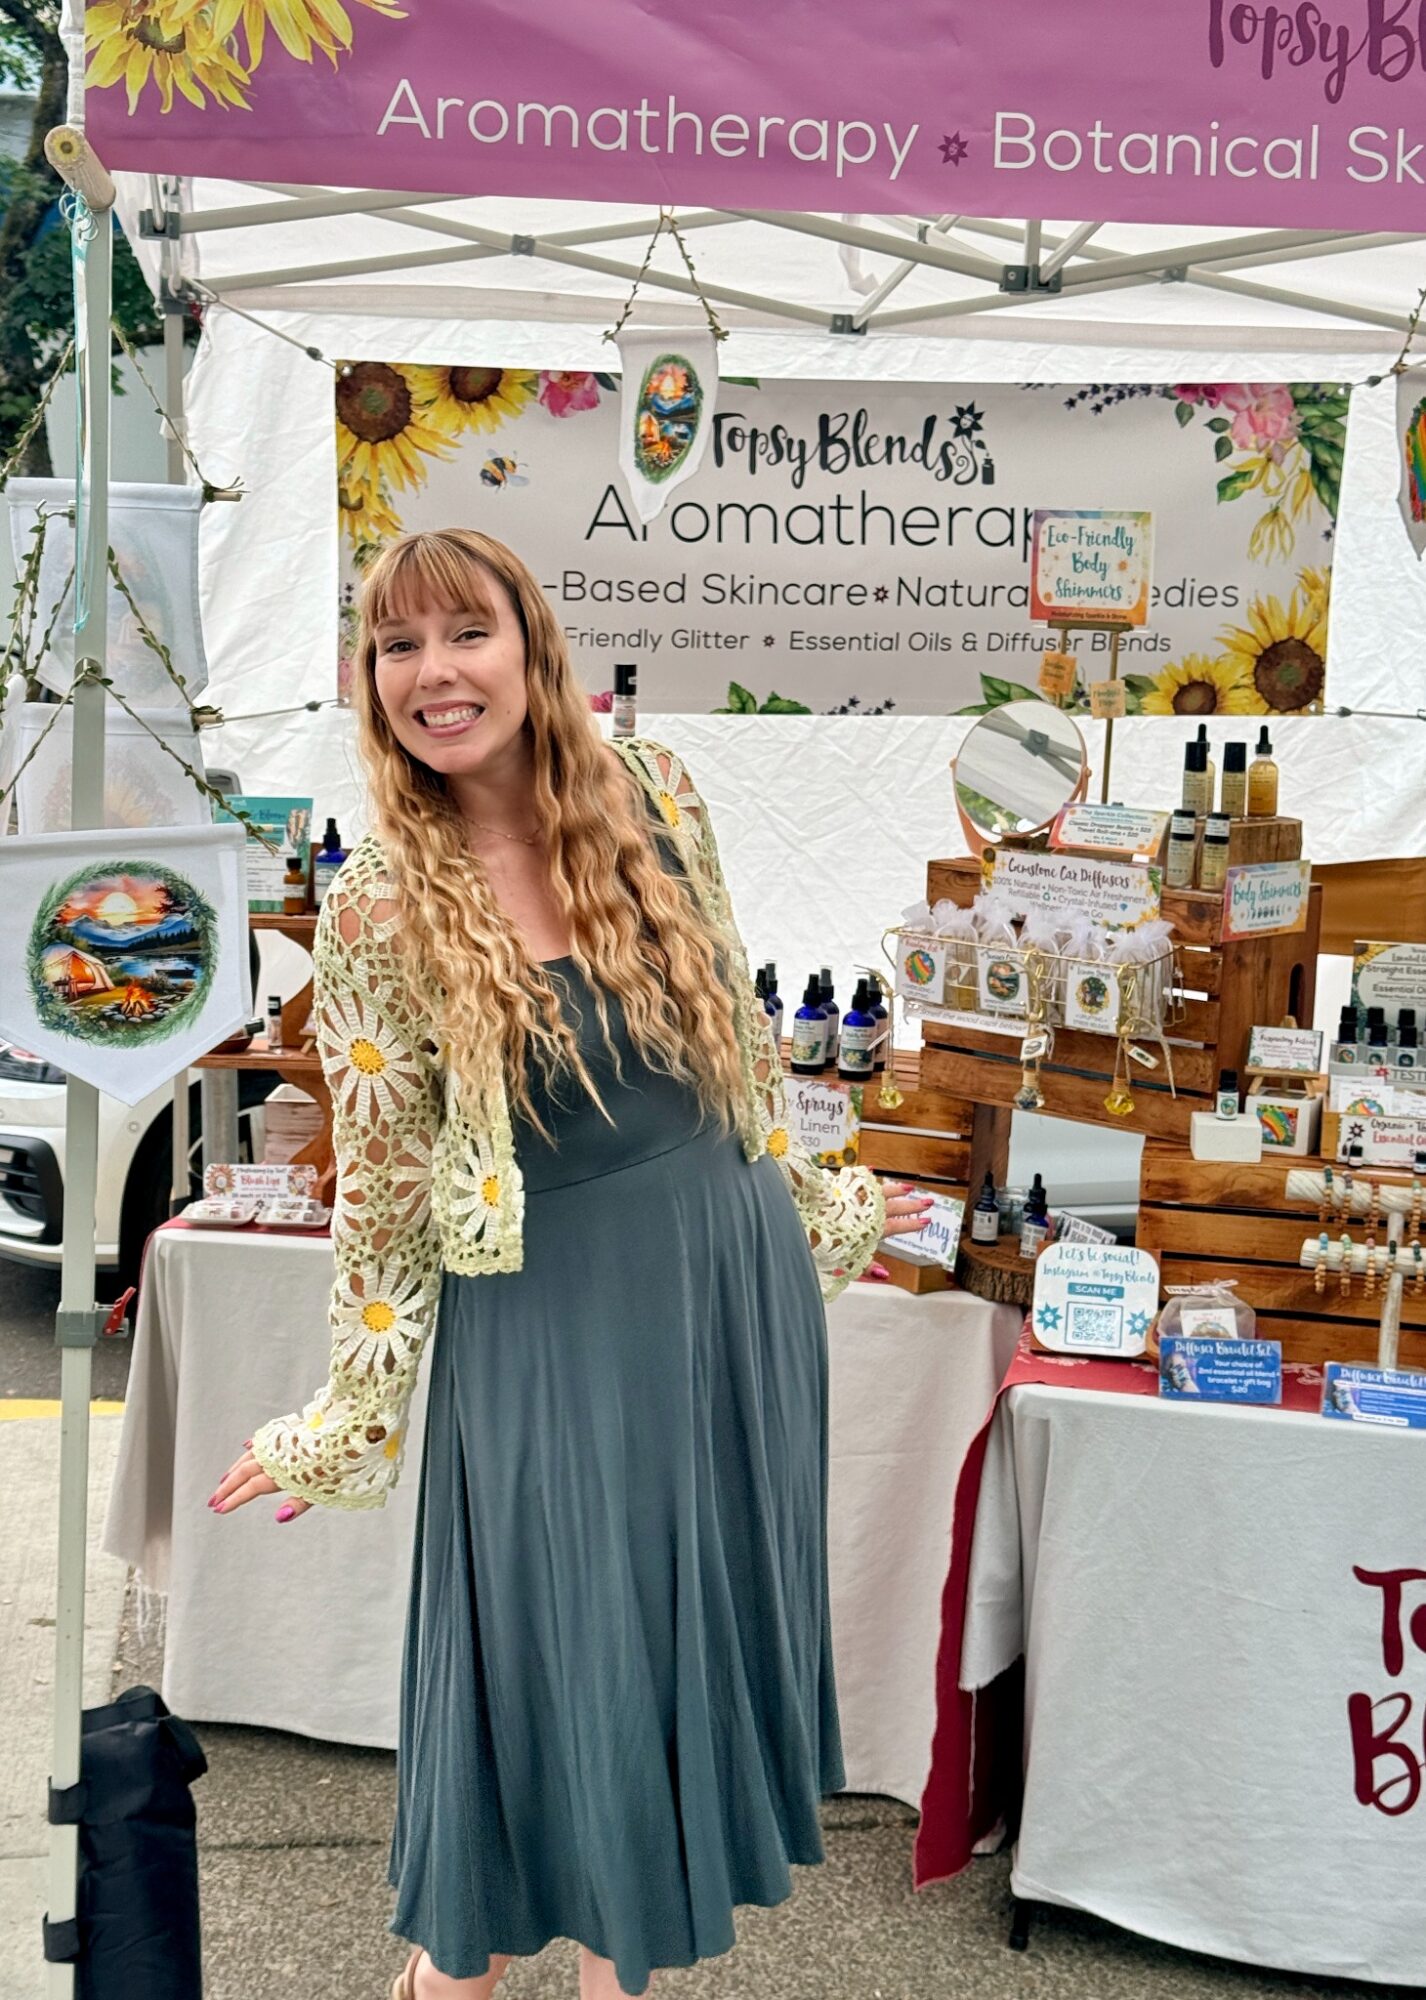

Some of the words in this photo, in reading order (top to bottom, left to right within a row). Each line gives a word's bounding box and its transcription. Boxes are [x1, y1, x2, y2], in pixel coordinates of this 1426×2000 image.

[376, 78, 920, 180] Aromatherapy
[993, 111, 1319, 180] Botanical
[1346, 126, 1426, 184] Sk
[1047, 524, 1135, 557] Eco-Friendly
[1071, 552, 1109, 582] Body
[702, 573, 868, 606] Skincare
[896, 576, 1029, 608] Natura
[1055, 577, 1123, 601] Shimmers
[671, 628, 750, 650] Glitter
[788, 630, 899, 652] Essential
[908, 631, 952, 652] Oils
[961, 631, 978, 652] &
[986, 631, 1084, 652] Diffuser
[1008, 857, 1057, 879] Gemstone
[1059, 865, 1078, 882] Car
[1080, 867, 1130, 890] Diffusers
[993, 875, 1013, 887] 100%
[1013, 878, 1041, 891] Natural
[1048, 883, 1089, 897] Non-Toxic
[1089, 889, 1101, 898] Air
[1103, 890, 1147, 905] Fresheners
[1008, 888, 1041, 900] Refillable
[1057, 894, 1118, 912] Crystal-Infused
[1090, 908, 1104, 919] Go
[1366, 963, 1405, 976] Straight
[1372, 983, 1415, 994] Essential
[1390, 1068, 1426, 1081] TEST
[796, 1090, 843, 1121] Sprays
[800, 1117, 840, 1135] Linen
[1370, 1119, 1406, 1131] Organic
[1058, 1245, 1084, 1262] Let's
[1087, 1247, 1098, 1262] be
[1101, 1249, 1141, 1267] social!
[1043, 1263, 1089, 1279] Instagram
[1074, 1285, 1101, 1295] SCAN
[1102, 1287, 1118, 1296] ME
[1174, 1340, 1214, 1357] Diffuser
[1215, 1341, 1255, 1357] Bracelet
[1255, 1343, 1272, 1358] Set
[1213, 1368, 1246, 1376] essential
[1214, 1360, 1231, 1368] Your
[1230, 1360, 1254, 1369] choice
[1207, 1376, 1238, 1385] bracelet
[1243, 1377, 1256, 1388] gift
[1256, 1378, 1272, 1389] bag
[1340, 1367, 1382, 1384] Diffuser
[1230, 1385, 1249, 1394] $20
